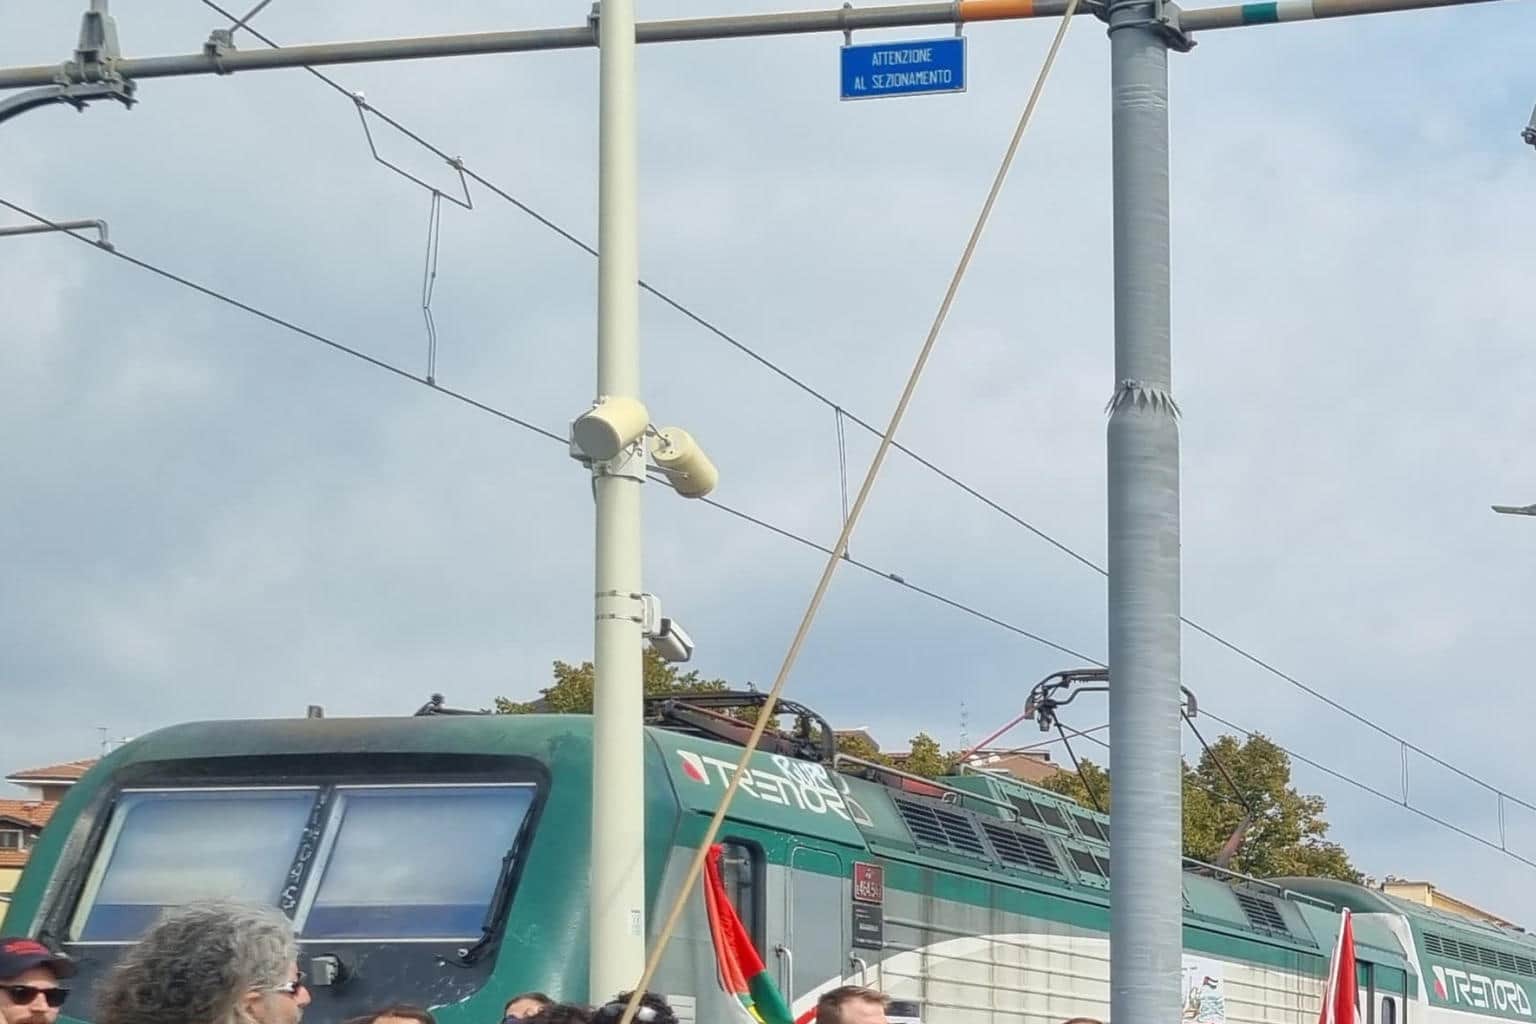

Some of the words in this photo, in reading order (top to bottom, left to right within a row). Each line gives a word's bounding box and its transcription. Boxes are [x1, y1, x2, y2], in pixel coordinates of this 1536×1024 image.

[872, 48, 933, 66] ATTENZIONE
[854, 76, 867, 90] AL
[872, 69, 952, 89] SEZIONAMENTO
[703, 755, 875, 829] TRENORD
[1444, 967, 1532, 1016] TRENORD
